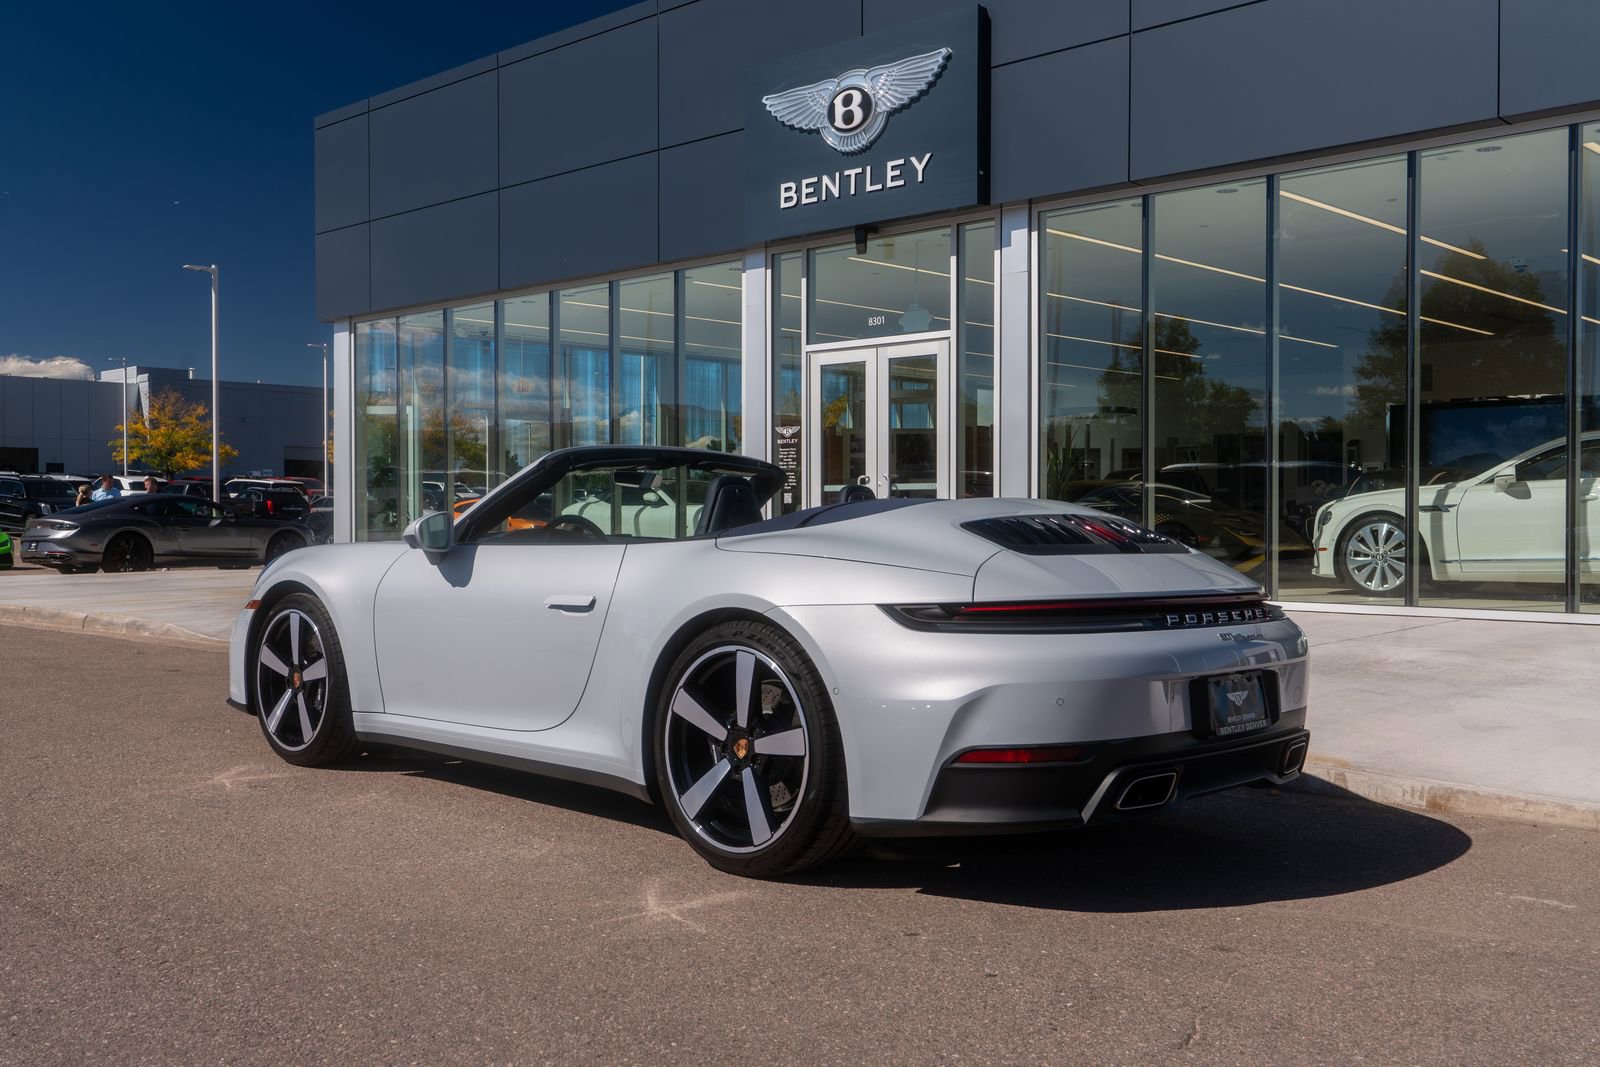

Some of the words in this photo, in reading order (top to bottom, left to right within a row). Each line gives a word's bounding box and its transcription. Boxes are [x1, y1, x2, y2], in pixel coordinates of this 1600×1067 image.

[833, 89, 864, 129] B
[780, 153, 933, 209] BENTLEY
[868, 316, 885, 326] 8301
[1166, 608, 1264, 626] PORSCHE
[1219, 723, 1245, 735] BENTLEY
[1245, 719, 1267, 731] DENVER
